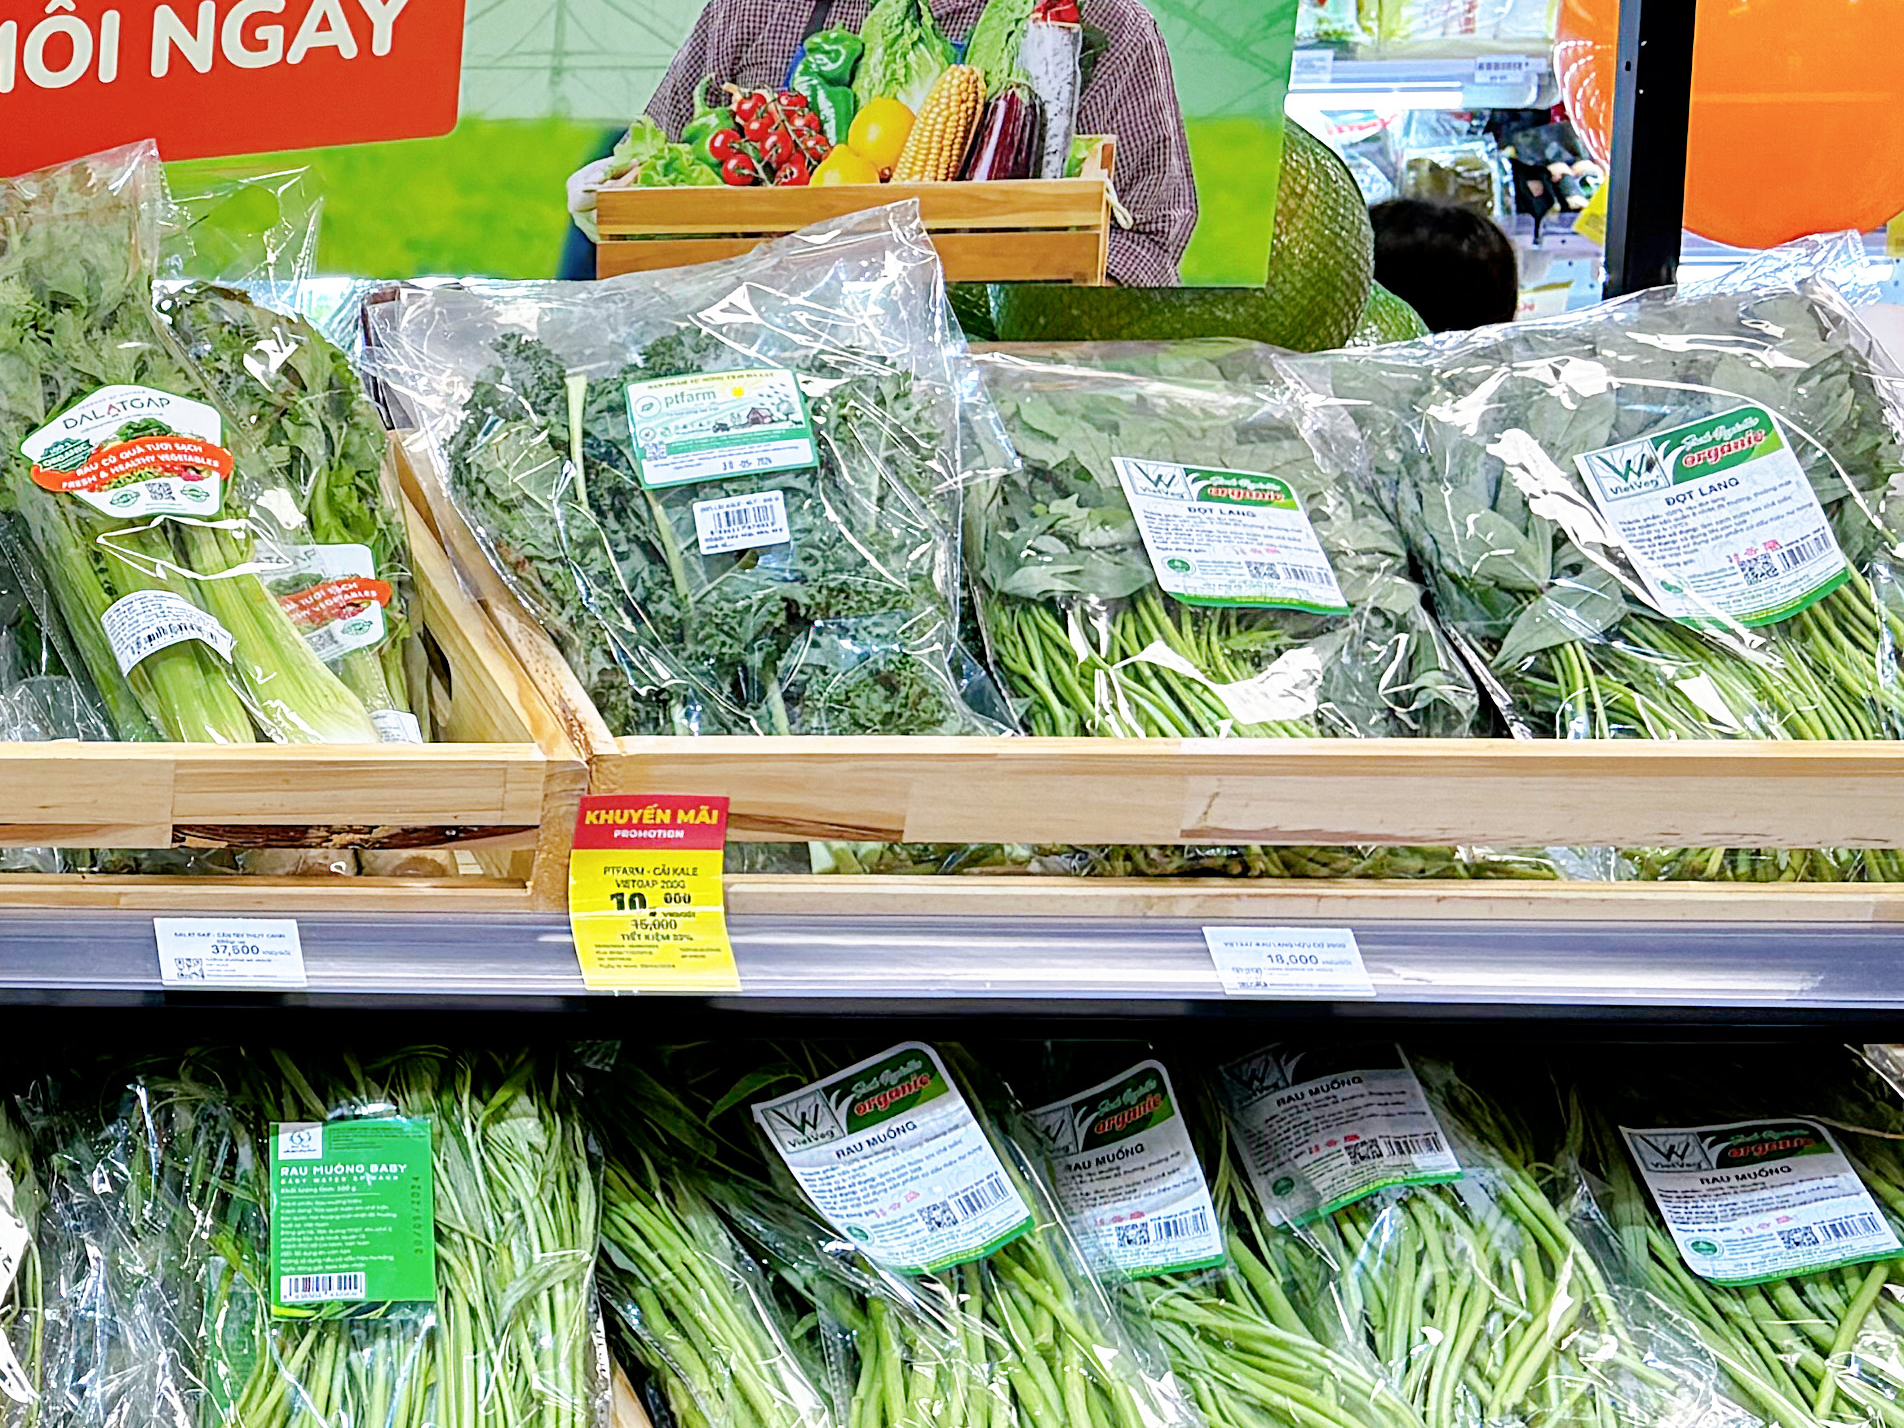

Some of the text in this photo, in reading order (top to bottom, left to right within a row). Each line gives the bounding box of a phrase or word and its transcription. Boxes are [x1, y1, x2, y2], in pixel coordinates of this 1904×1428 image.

[584, 804, 719, 825] KHUYẾN MÃI
[280, 1162, 407, 1177] RAU MUỐNG BABY
